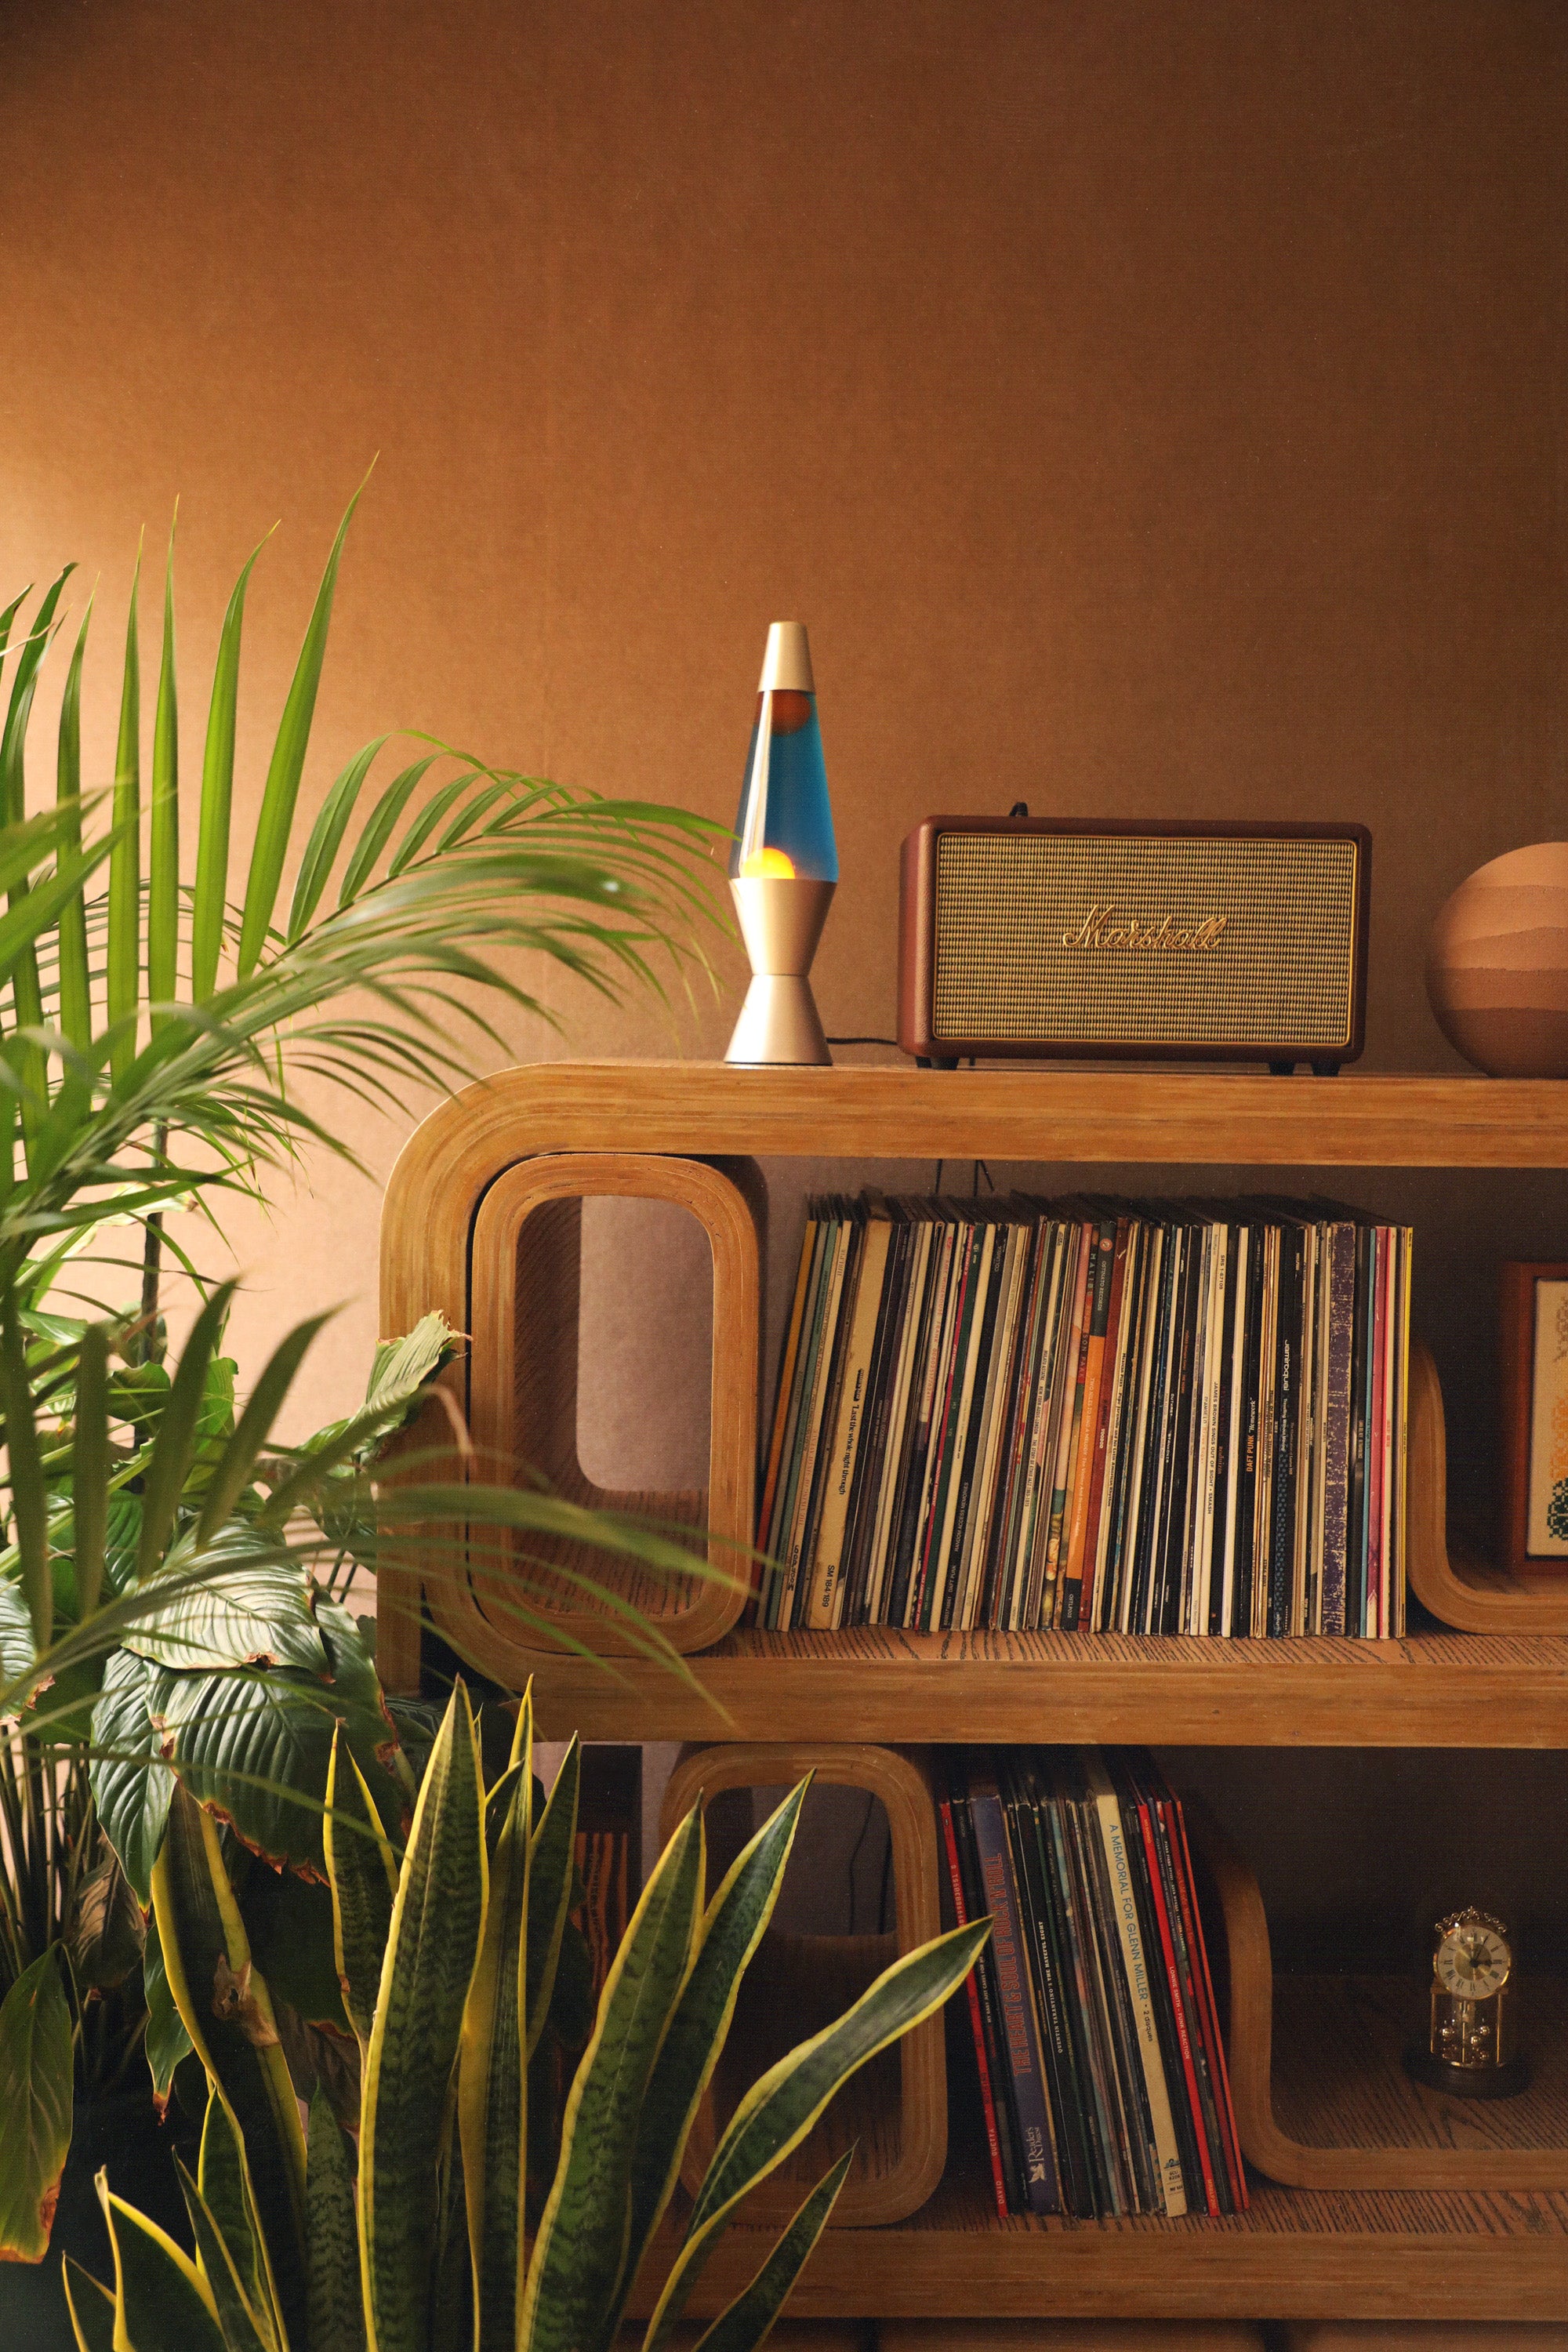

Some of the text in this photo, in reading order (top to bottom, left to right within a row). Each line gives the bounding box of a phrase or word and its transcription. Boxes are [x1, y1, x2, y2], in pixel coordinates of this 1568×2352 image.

[1062, 905, 1227, 950] Marshall
[993, 1244, 1003, 1272] COLUMBIA
[1086, 1252, 1097, 1297] MALIBU
[1096, 1260, 1107, 1312] OSTINATO RECORDS
[936, 1275, 947, 1316] WINEHOUSE
[932, 1320, 941, 1344] FRANK
[1281, 1338, 1290, 1392] Jamiroquai
[848, 1421, 857, 1432] the
[844, 1432, 855, 1453] whole
[840, 1450, 851, 1469] night
[1245, 1453, 1254, 1472] DAFT
[837, 1468, 848, 1495] through
[959, 1481, 969, 1509] MEMORIES
[956, 1508, 965, 1530] ACCESS
[953, 1529, 962, 1552] RANDOM
[826, 1563, 835, 1578] SM
[946, 1578, 955, 1593] DAFT
[1108, 1823, 1120, 1833] A
[1110, 1835, 1130, 1895] MEMORIAL
[1121, 1896, 1135, 1920] FOR
[1037, 1920, 1046, 1941] EIGHT
[1125, 1922, 1142, 1961] GLENN
[993, 1937, 1015, 1957] OF
[1040, 1940, 1050, 1969] HATEFUL
[979, 1973, 988, 1990] CARES
[996, 1955, 1021, 1991] SOUL
[1044, 1968, 1052, 1982] THE
[1133, 1962, 1149, 2001] MILLER
[1001, 1990, 1022, 2004] &
[1003, 2002, 1029, 2049] HEART
[1168, 1965, 1190, 2060] LONNIE SMITH FUNK REACTION
[1053, 2024, 1063, 2054] QUENTIN
[1142, 2016, 1154, 2042] disques
[1010, 2048, 1033, 2076] THE
[1022, 2125, 1045, 2163] Reader's
[987, 2127, 1005, 2205] DAVID GUETTA
